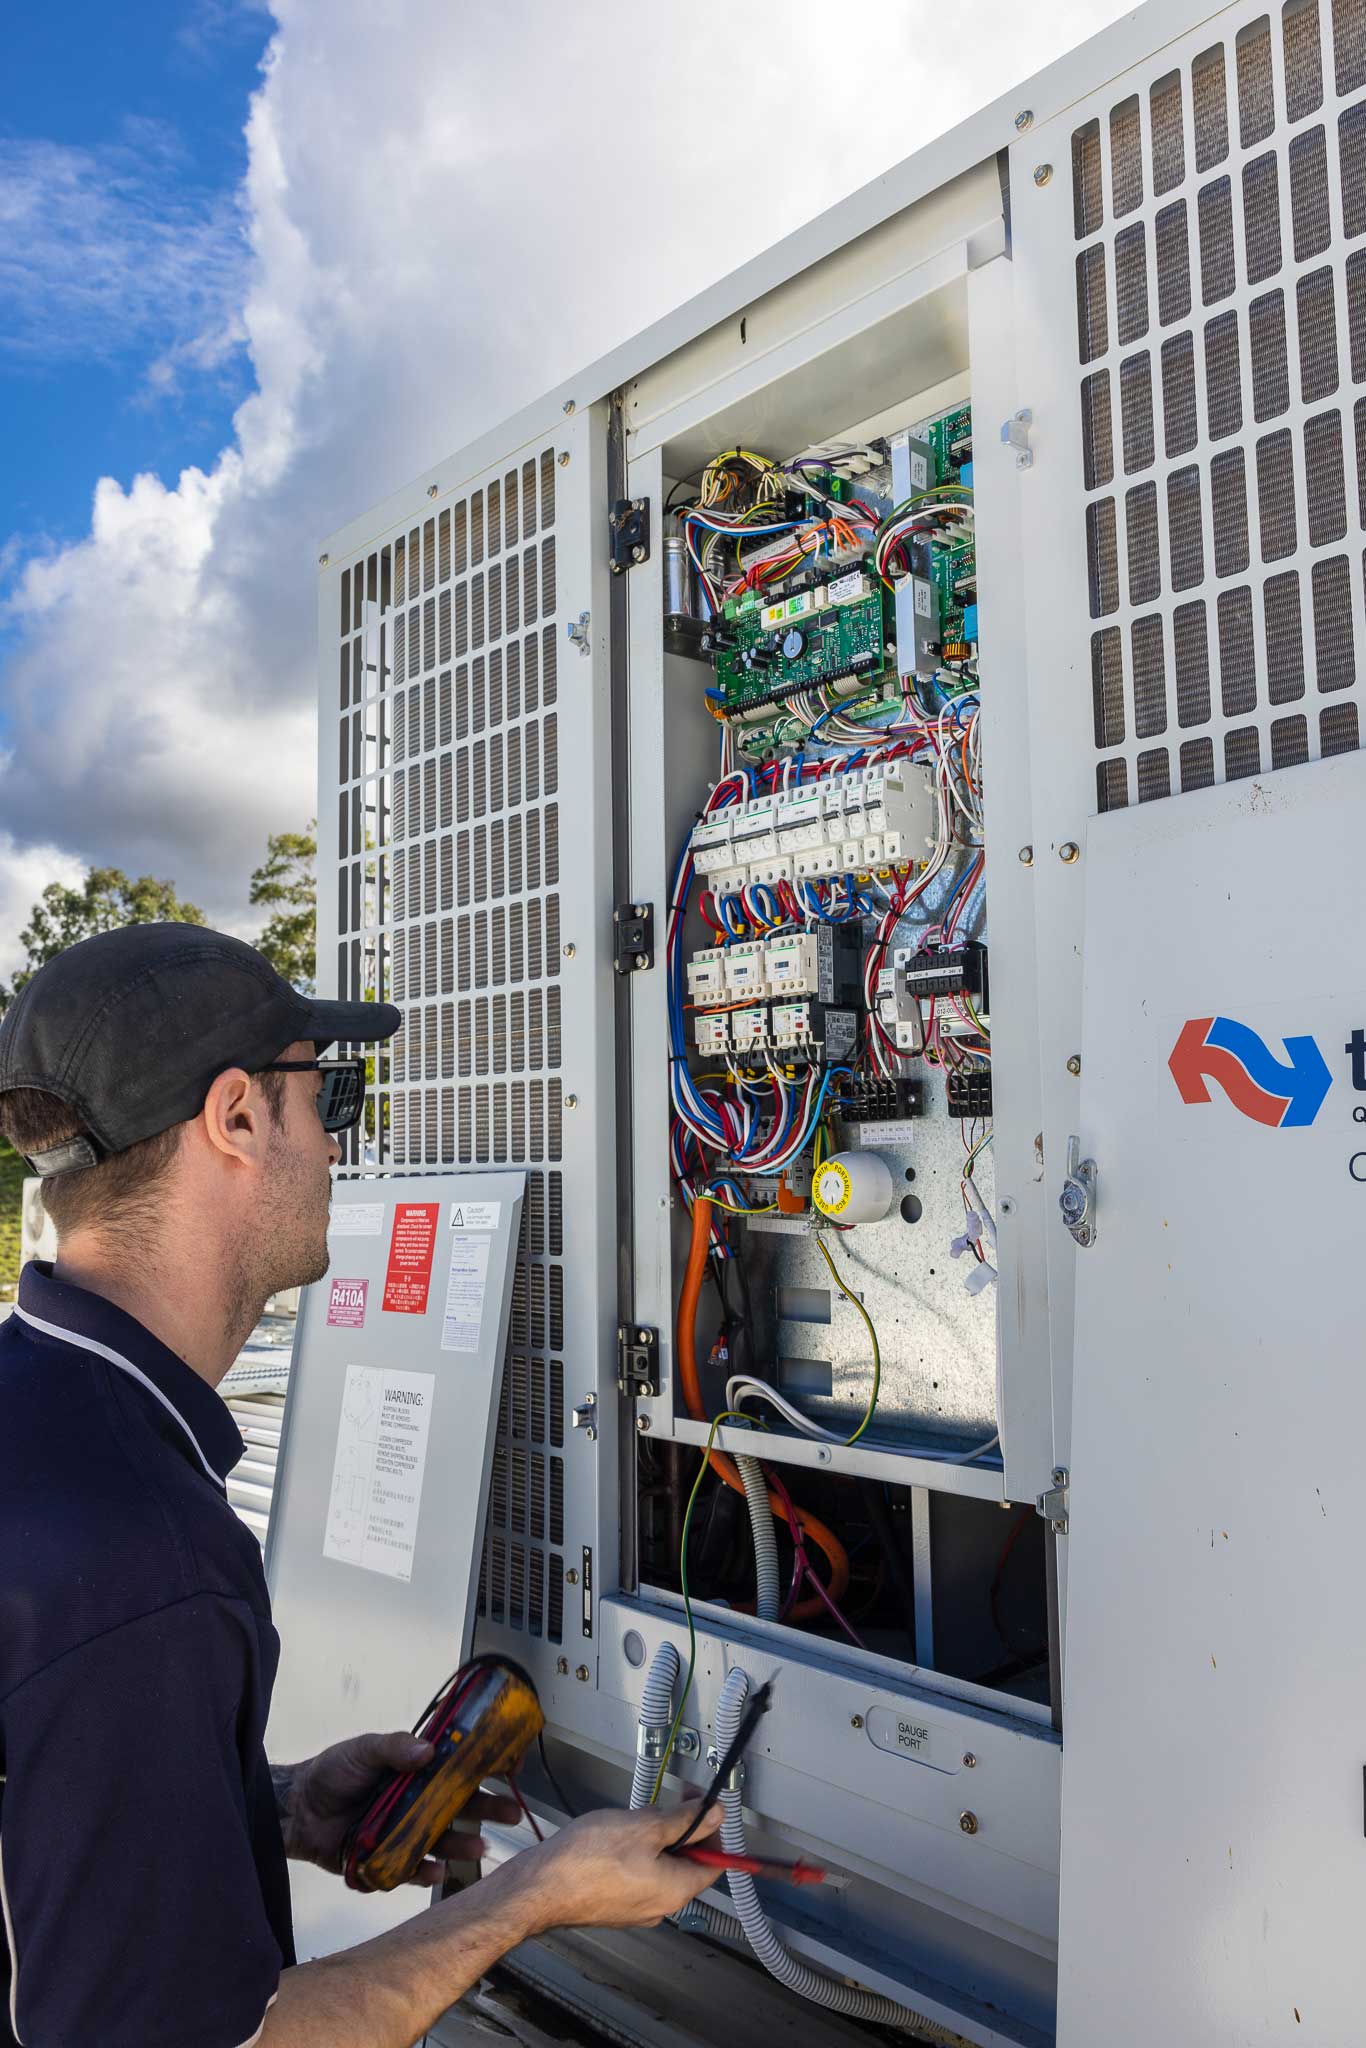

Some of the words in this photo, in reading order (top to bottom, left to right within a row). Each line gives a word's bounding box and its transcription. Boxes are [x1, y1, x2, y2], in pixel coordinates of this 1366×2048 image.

[1345, 1029, 1366, 1091] t
[1353, 1106, 1366, 1123] Q
[817, 1165, 828, 1178] WITH
[405, 1209, 427, 1217] WARNING
[331, 1288, 364, 1307] R410A
[384, 1389, 424, 1406] WARNING:
[898, 1722, 928, 1740] GAUGE
[898, 1735, 922, 1750] PORT
